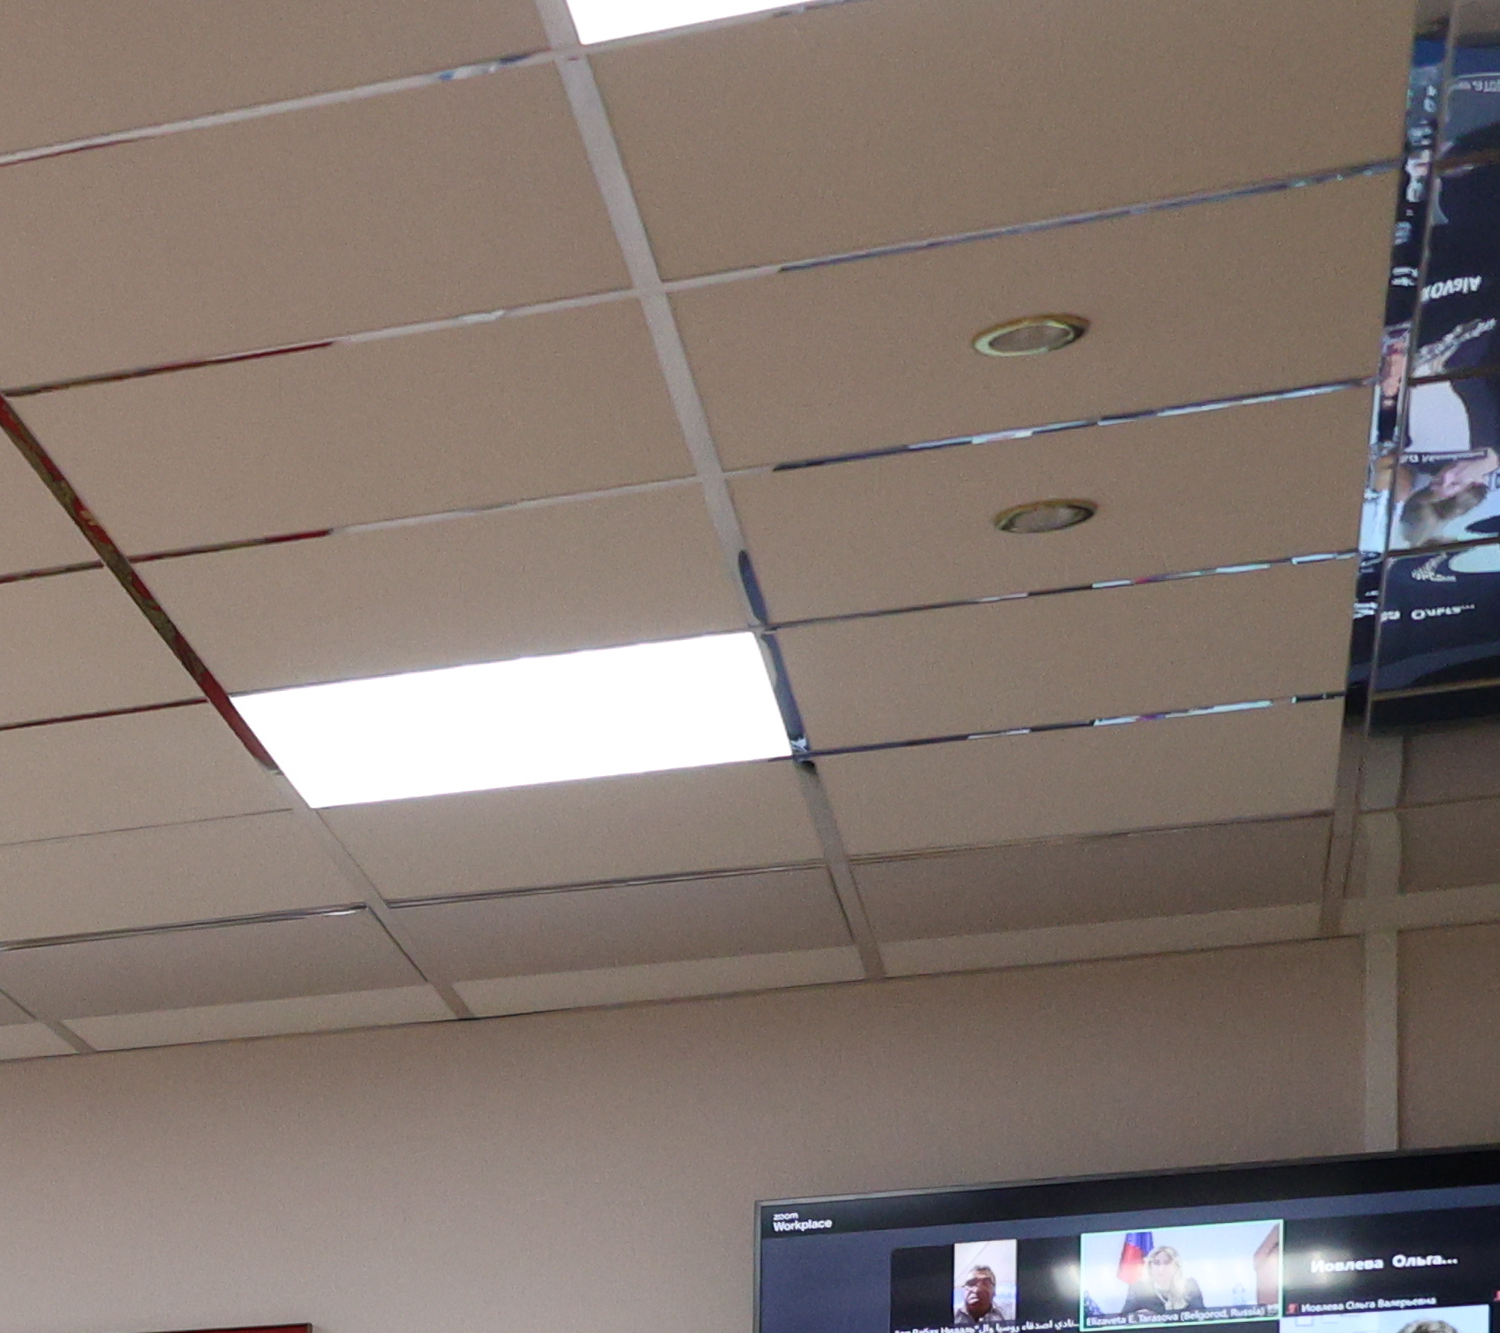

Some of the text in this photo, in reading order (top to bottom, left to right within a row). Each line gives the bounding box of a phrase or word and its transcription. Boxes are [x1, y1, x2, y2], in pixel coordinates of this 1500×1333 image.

[773, 1212, 799, 1221] zoom
[773, 1217, 833, 1233] Workplace
[1311, 1257, 1383, 1274] Иовлева
[1086, 1313, 1127, 1327] Elizaveta
[1138, 1310, 1179, 1324] Tarasova
[1230, 1305, 1266, 1320] Russia)
